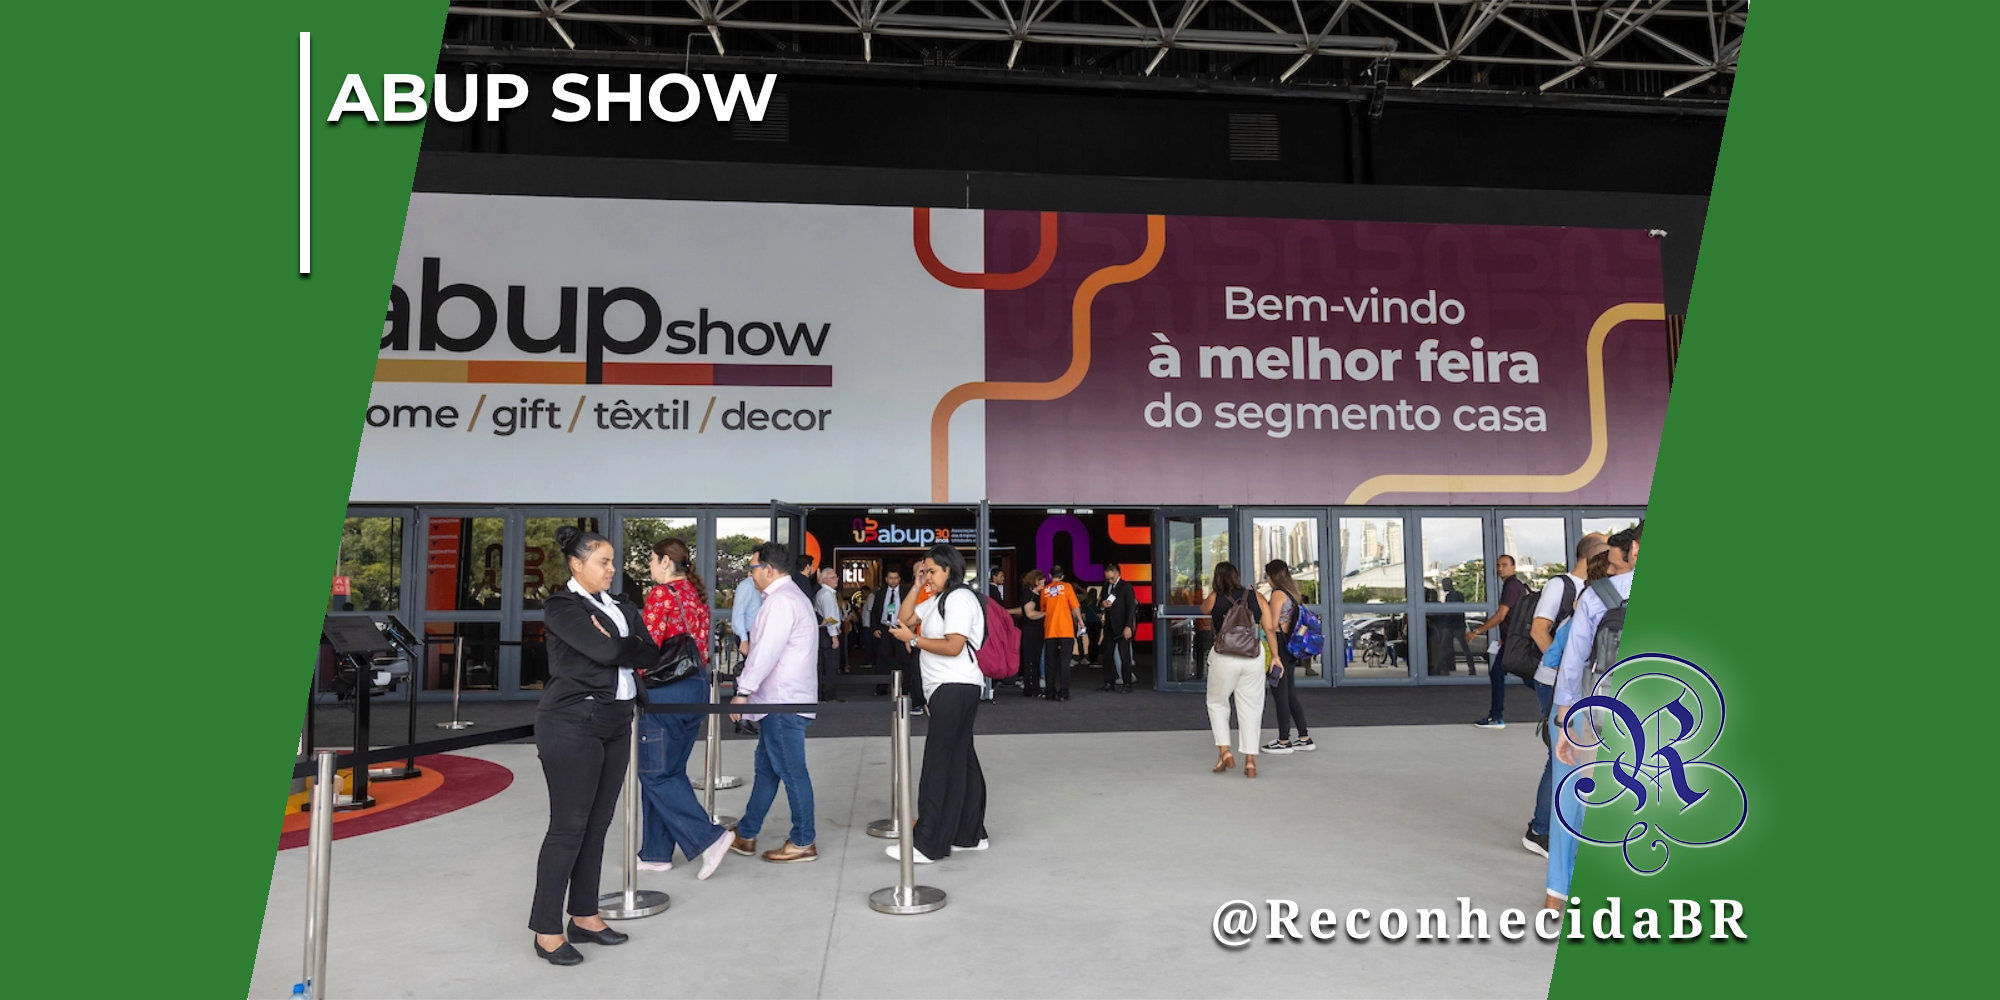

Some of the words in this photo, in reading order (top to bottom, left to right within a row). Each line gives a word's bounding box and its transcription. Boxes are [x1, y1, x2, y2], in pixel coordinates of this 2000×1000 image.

[1224, 286, 1466, 325] Bem-vindo
[665, 308, 832, 357] show
[1148, 332, 1182, 379] à
[1199, 336, 1403, 381] melhor
[1415, 336, 1540, 384] feira
[365, 402, 459, 429] ome
[492, 397, 562, 437] gift
[594, 399, 690, 431] têxtil
[721, 401, 833, 432] decor
[1144, 392, 1203, 429] do
[1214, 399, 1441, 438] segmento
[1452, 404, 1548, 433] casa
[877, 524, 935, 547] abup
[935, 528, 950, 538] 30
